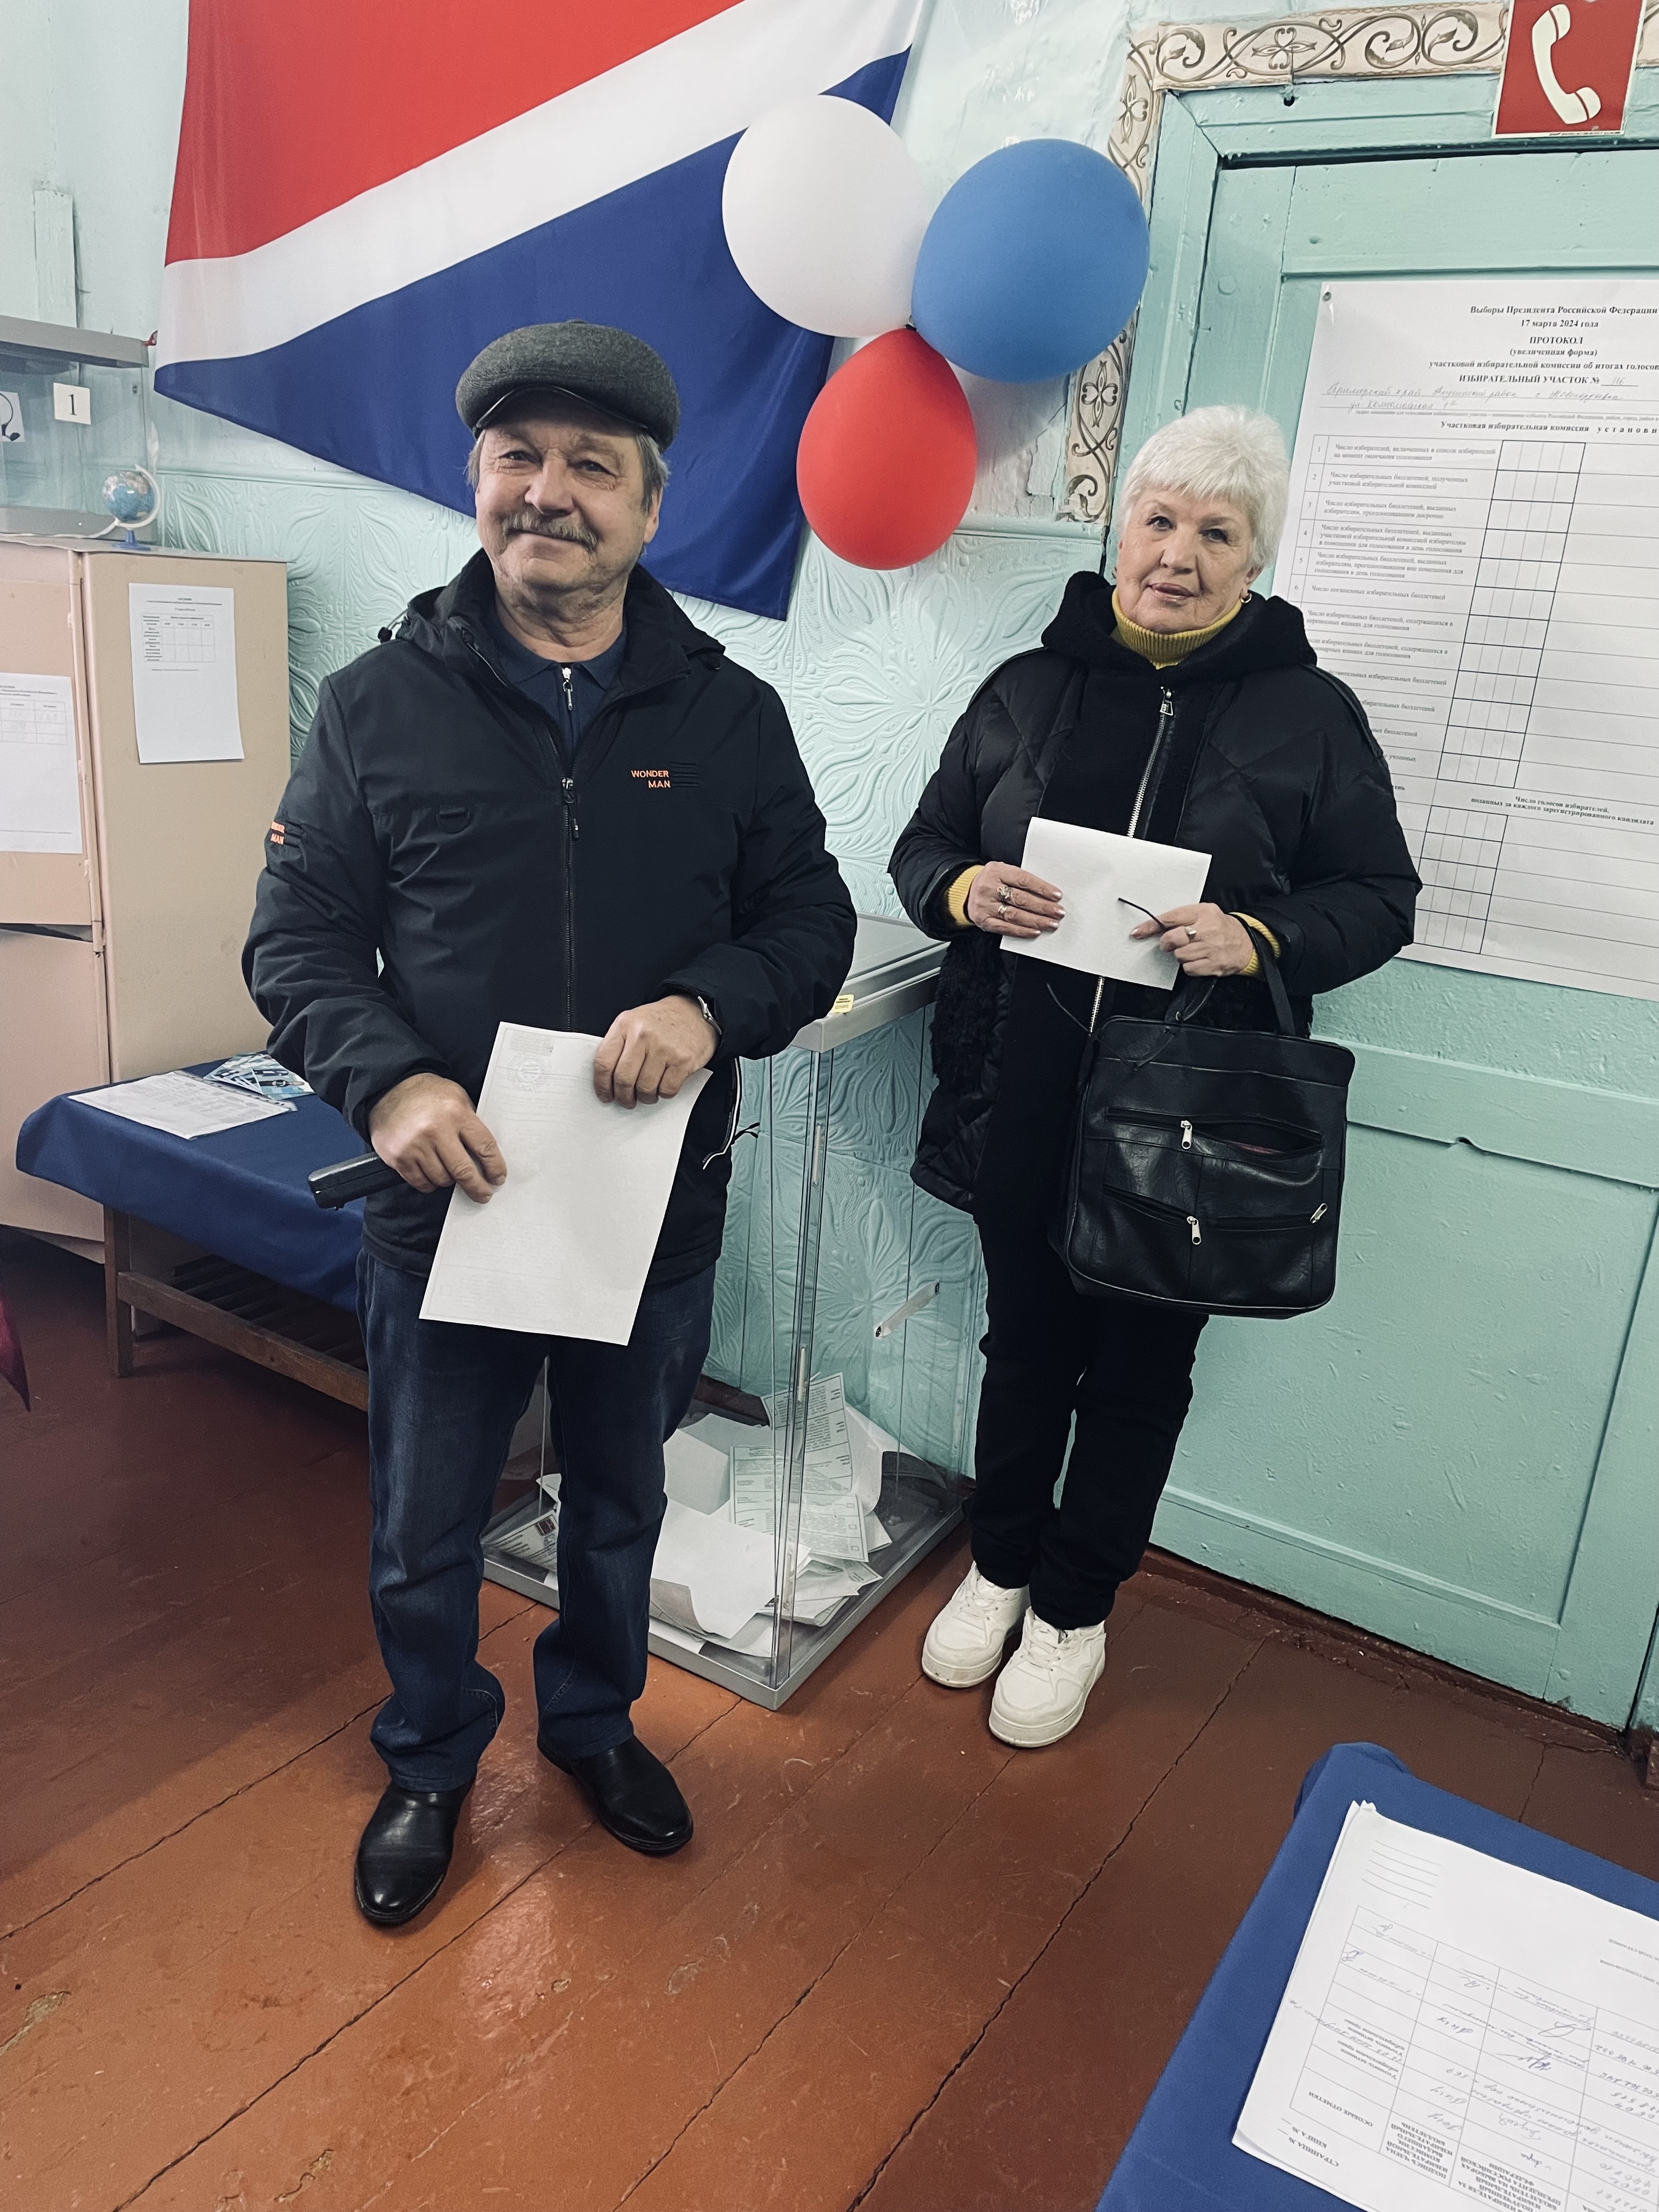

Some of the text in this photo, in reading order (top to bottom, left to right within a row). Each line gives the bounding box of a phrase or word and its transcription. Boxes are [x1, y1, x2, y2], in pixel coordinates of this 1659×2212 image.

[1470, 306, 1658, 316] Выборы Президента Российской Федерации
[1430, 360, 1475, 369] участковой
[1477, 360, 1538, 370] избирательной
[1510, 348, 1597, 358] (увеличенная форма)
[1459, 375, 1541, 383] ИЗБИРАТЕЛЬНЫЙ
[1542, 376, 1588, 384] УЧАСТОК
[69, 393, 77, 416] 1
[1441, 421, 1486, 429] Участковая
[1488, 422, 1548, 431] избирательная
[630, 770, 669, 778] WONDER
[648, 780, 671, 788] MAN
[1515, 795, 1536, 804] Число
[1471, 798, 1503, 806] поданных
[1543, 807, 1616, 820] зарегистрированного
[1617, 816, 1654, 826] кандидата
[1308, 2091, 1373, 2127] ОСОБЫЕ ОТМЕТКИ
[1292, 2126, 1327, 2149] КНИГА №
[1391, 2123, 1453, 2156] ИЗБИРАТЕЛЬНЫЙ
[1397, 2133, 1443, 2158] ВЫДАВШЕГО
[1401, 2122, 1446, 2147] БЮЛЛЕТЕНЬ
[1288, 2136, 1339, 2167] СТРАНИЦА №
[1386, 2140, 1448, 2173] ИЗБИРАТЕЛЬНОЙ
[1386, 2146, 1447, 2179] ПОДПИСЬ ЧЛЕНА
[1460, 2156, 1561, 2206] ПРЕЗИДЕНТА РОССИЙСКОЙ
[1461, 2162, 1497, 2183] ВЫБОРАХ
[1489, 2163, 1534, 2186] ФЕДЕРАЦИИ
[1468, 2185, 1516, 2212] ИЗБИРАТЕЛЯ
[1475, 2176, 1541, 2210] ИЗБИРАТЕЛЬНЫЙ
[1509, 2185, 1557, 2211] БЮЛЛЕТЕНЬ
